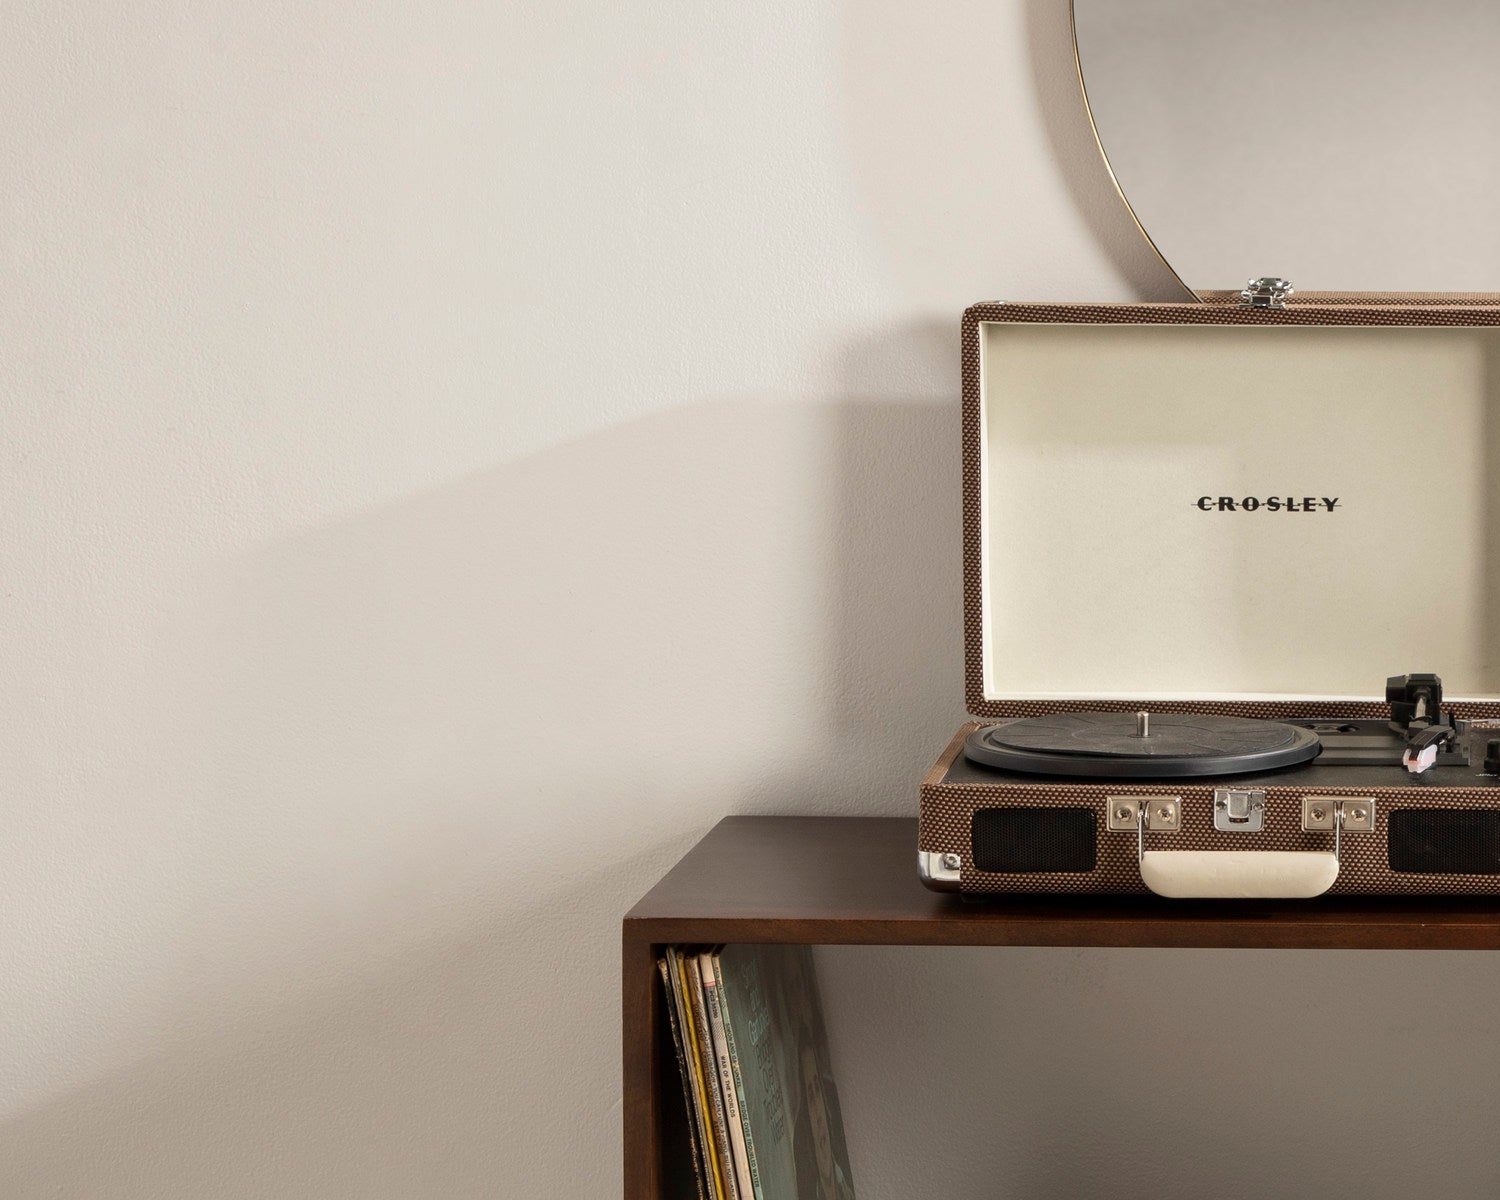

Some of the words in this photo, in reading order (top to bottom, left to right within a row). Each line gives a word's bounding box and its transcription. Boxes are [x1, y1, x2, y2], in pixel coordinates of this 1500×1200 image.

[1196, 496, 1340, 513] CROSLEY
[725, 1022, 734, 1042] SIMON
[731, 1055, 743, 1089] GAUNKEL
[723, 1070, 729, 1079] OF
[727, 1092, 736, 1118] WORLDS
[739, 1099, 748, 1121] BRIDGE
[743, 1121, 751, 1138] OVER
[746, 1138, 757, 1168] TROUBLED
[751, 1168, 761, 1188] WATER
